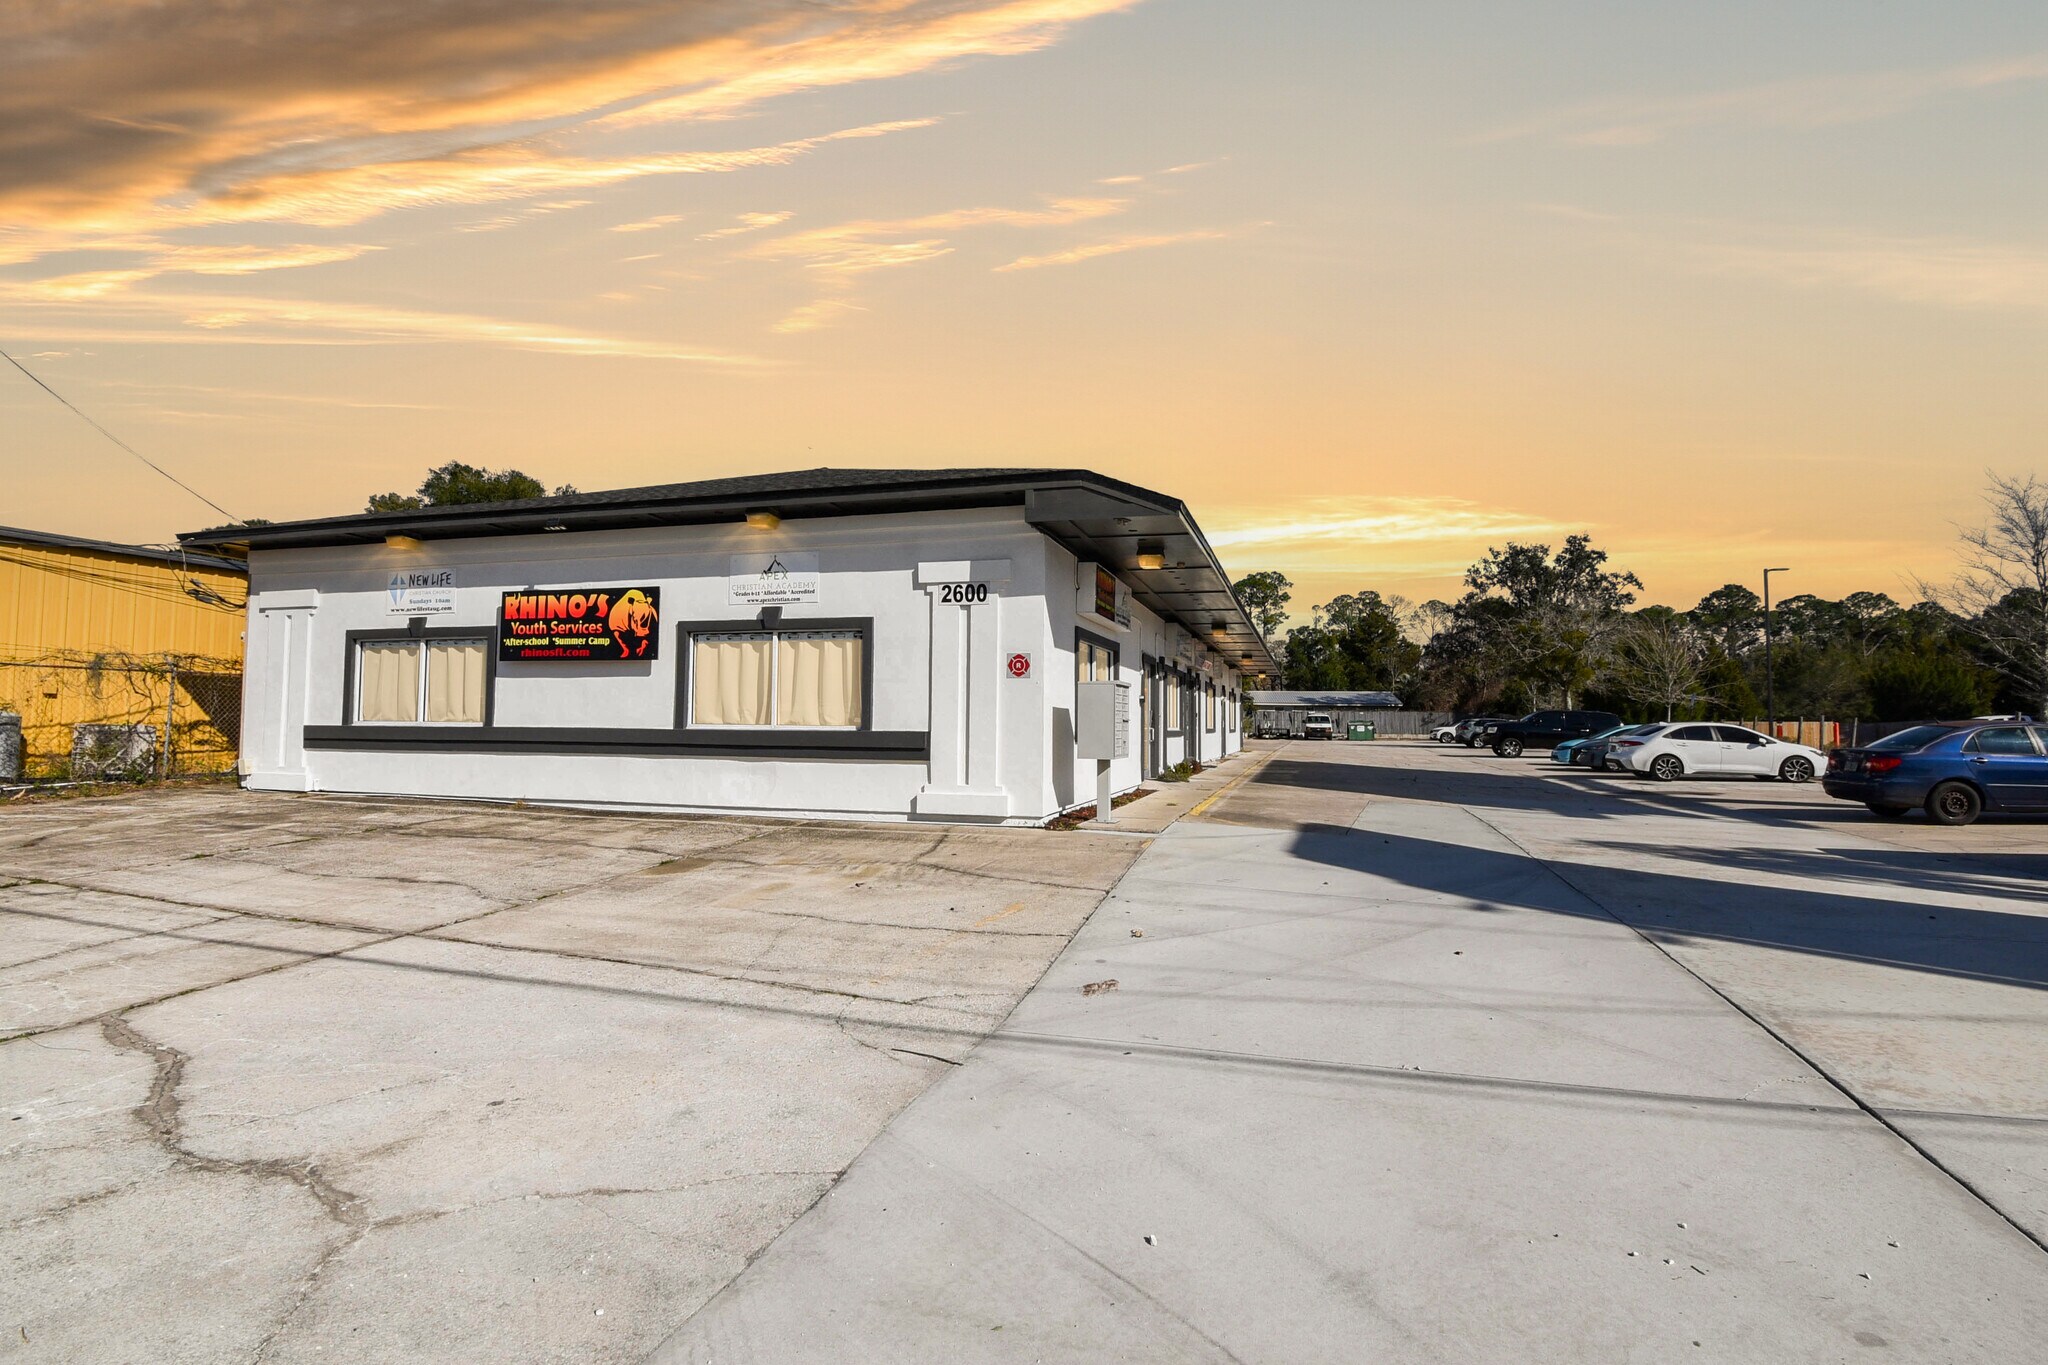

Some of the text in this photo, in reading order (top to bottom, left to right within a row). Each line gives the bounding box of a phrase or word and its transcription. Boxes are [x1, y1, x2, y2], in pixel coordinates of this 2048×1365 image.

[408, 572, 452, 587] NEW LIFE
[760, 571, 788, 580] APEX
[732, 582, 816, 591] CHRISTIAN ACADEMY
[941, 583, 988, 603] 2600
[505, 593, 609, 619] RHINO'S
[511, 620, 603, 635] Youth Services
[588, 637, 610, 646] Camp
[520, 648, 590, 657] rhinosfl.com
